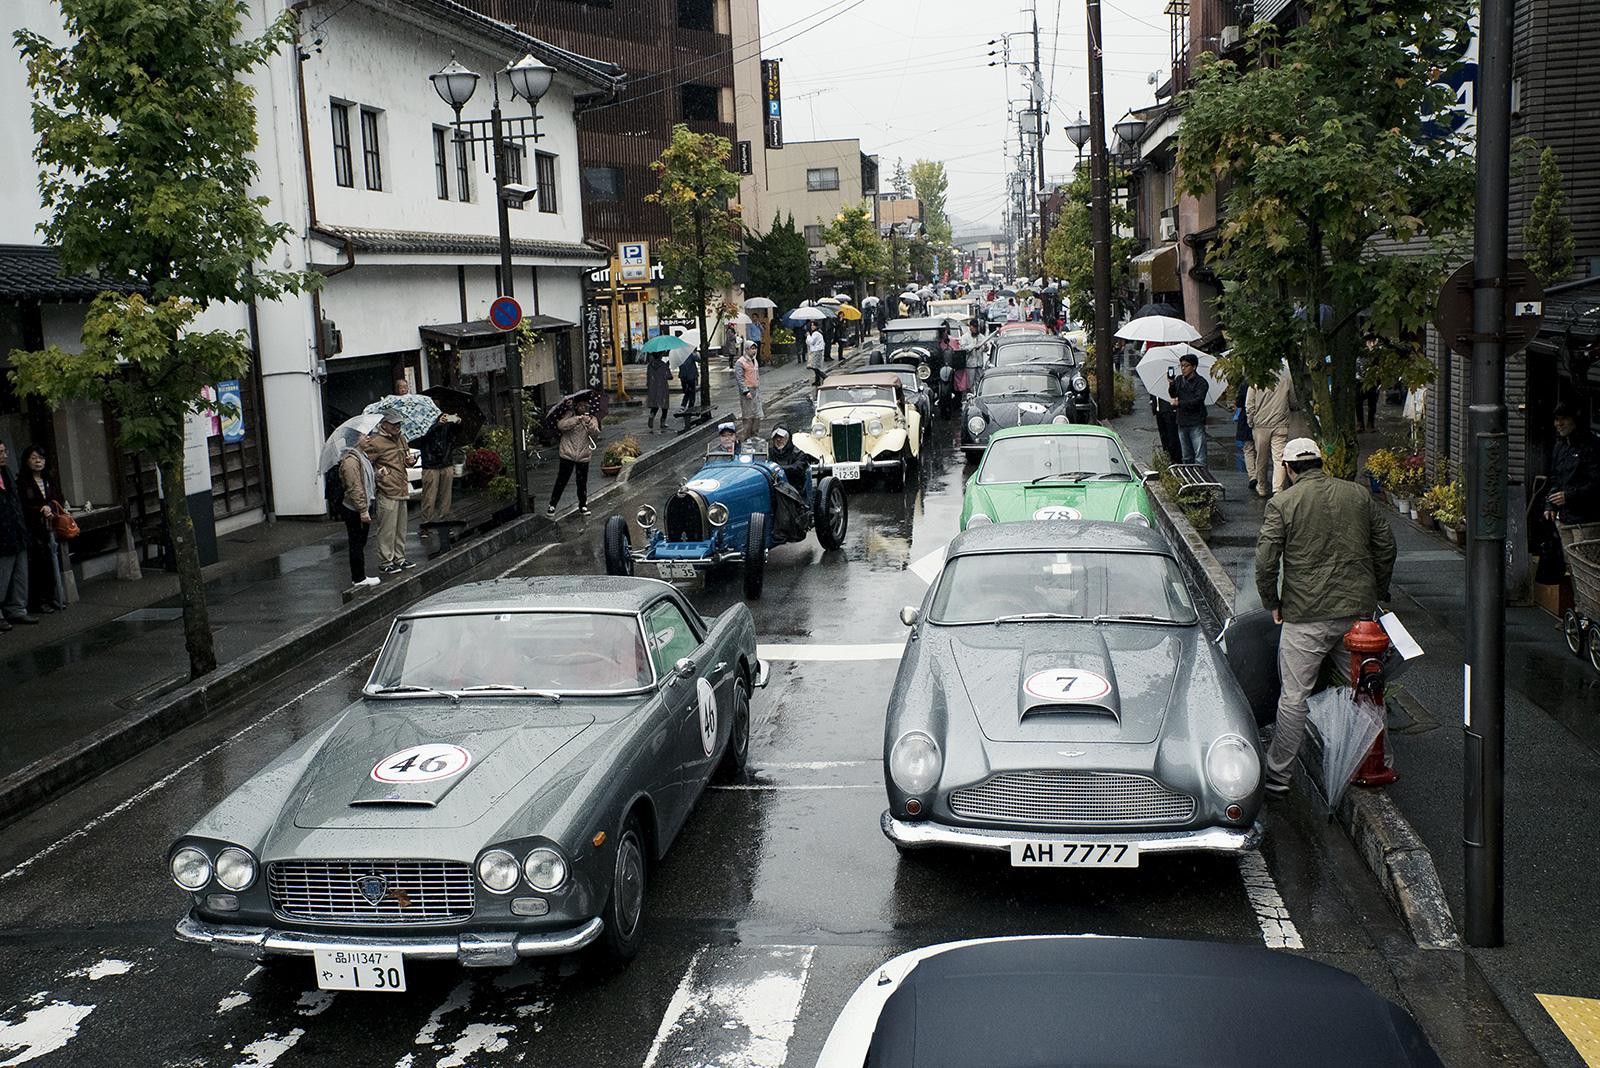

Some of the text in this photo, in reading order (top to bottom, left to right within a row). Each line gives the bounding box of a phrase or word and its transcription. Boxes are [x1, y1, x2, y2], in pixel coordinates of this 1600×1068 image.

[771, 102, 778, 114] P
[626, 246, 639, 258] P
[1044, 511, 1070, 520] 78
[1055, 676, 1079, 692] 7
[704, 695, 715, 740] 46
[389, 753, 449, 773] 46
[1022, 844, 1129, 863] AH 7777
